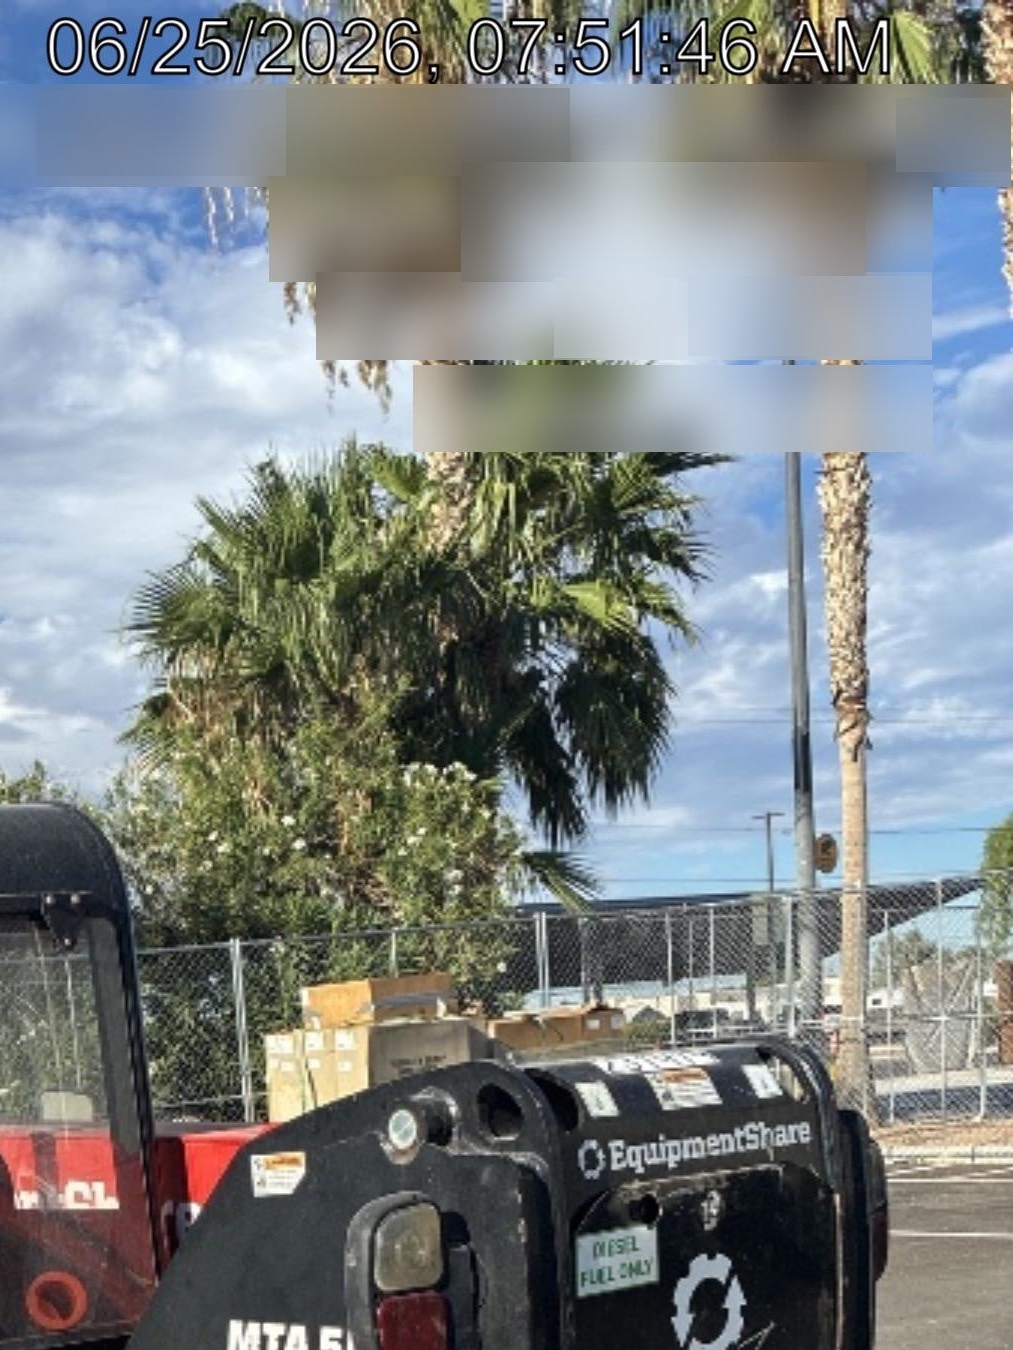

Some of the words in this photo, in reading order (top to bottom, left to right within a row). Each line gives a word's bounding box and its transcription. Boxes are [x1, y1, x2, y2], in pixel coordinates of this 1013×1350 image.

[607, 1121, 812, 1175] EquipmentShare
[592, 1235, 640, 1260] DIESEL
[580, 1266, 616, 1289] FUEL
[618, 1256, 655, 1279] ONLY
